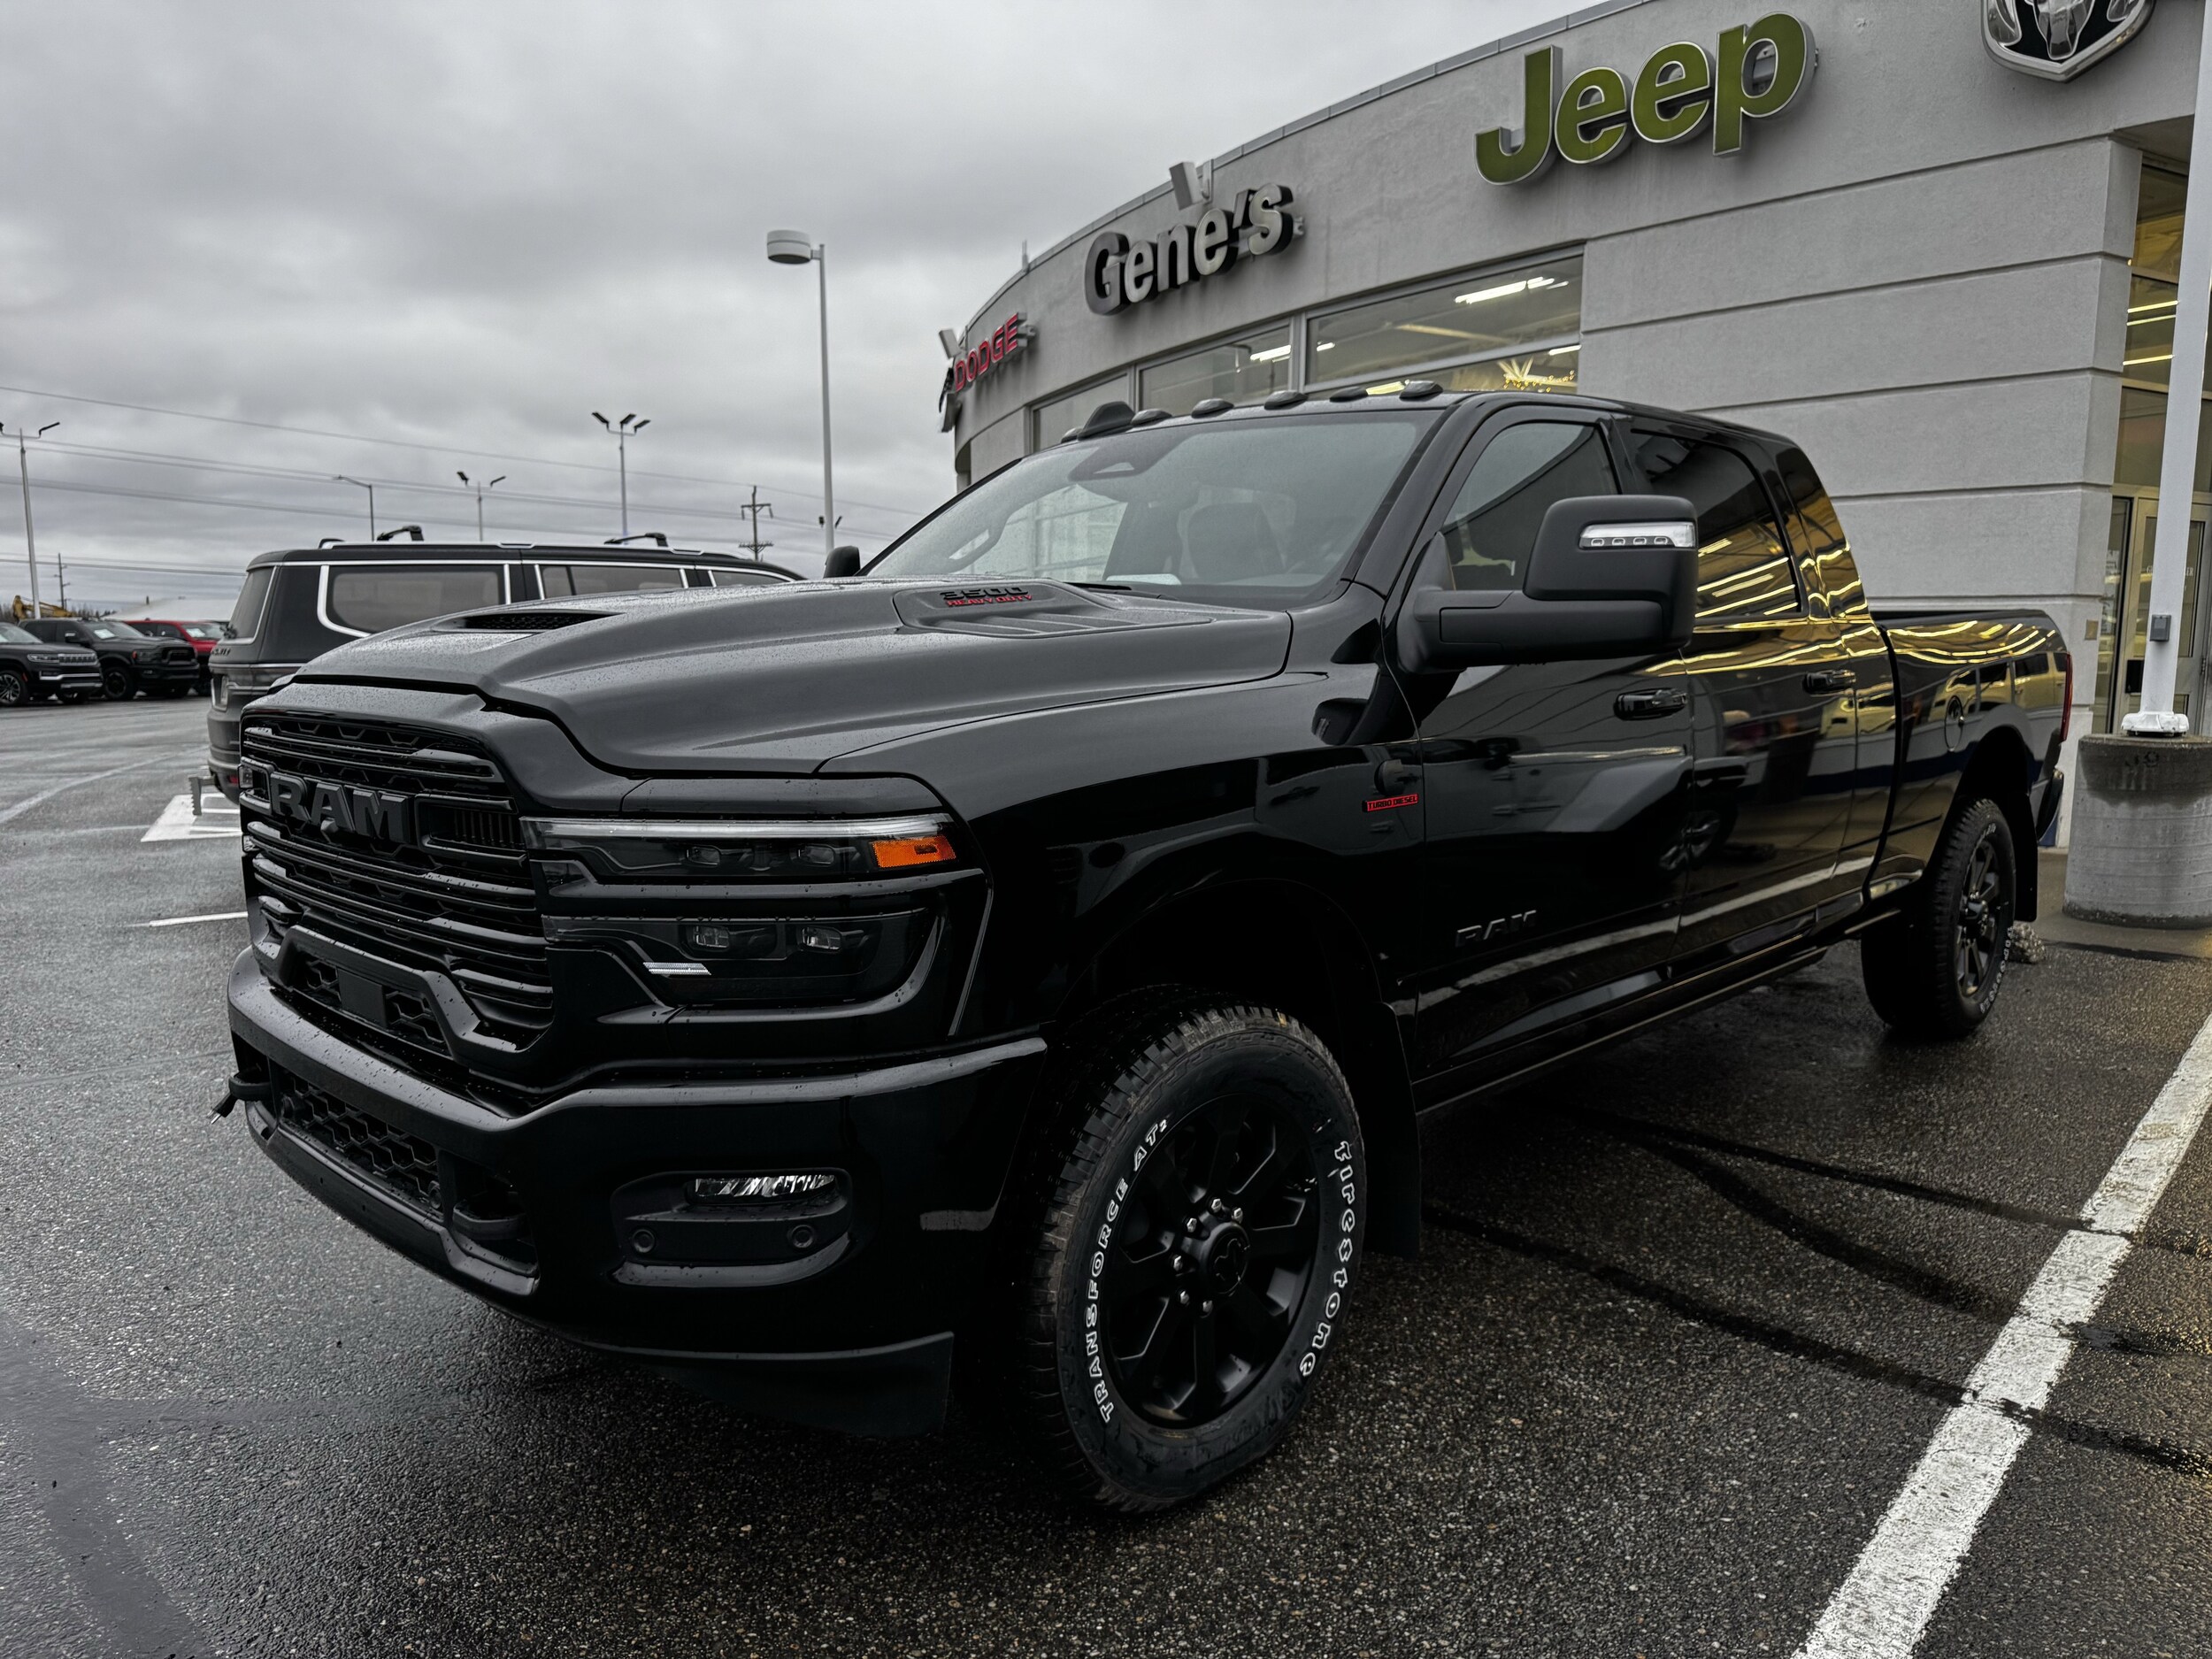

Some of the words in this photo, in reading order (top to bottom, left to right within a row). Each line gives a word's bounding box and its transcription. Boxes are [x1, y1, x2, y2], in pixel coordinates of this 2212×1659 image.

[1474, 11, 1811, 187] Jeep
[1085, 182, 1292, 317] Gene's
[954, 311, 1020, 392] DODGE
[270, 772, 410, 843] RAM
[1455, 909, 1538, 948] RAM
[1085, 1177, 1129, 1424] TRANSFORCE
